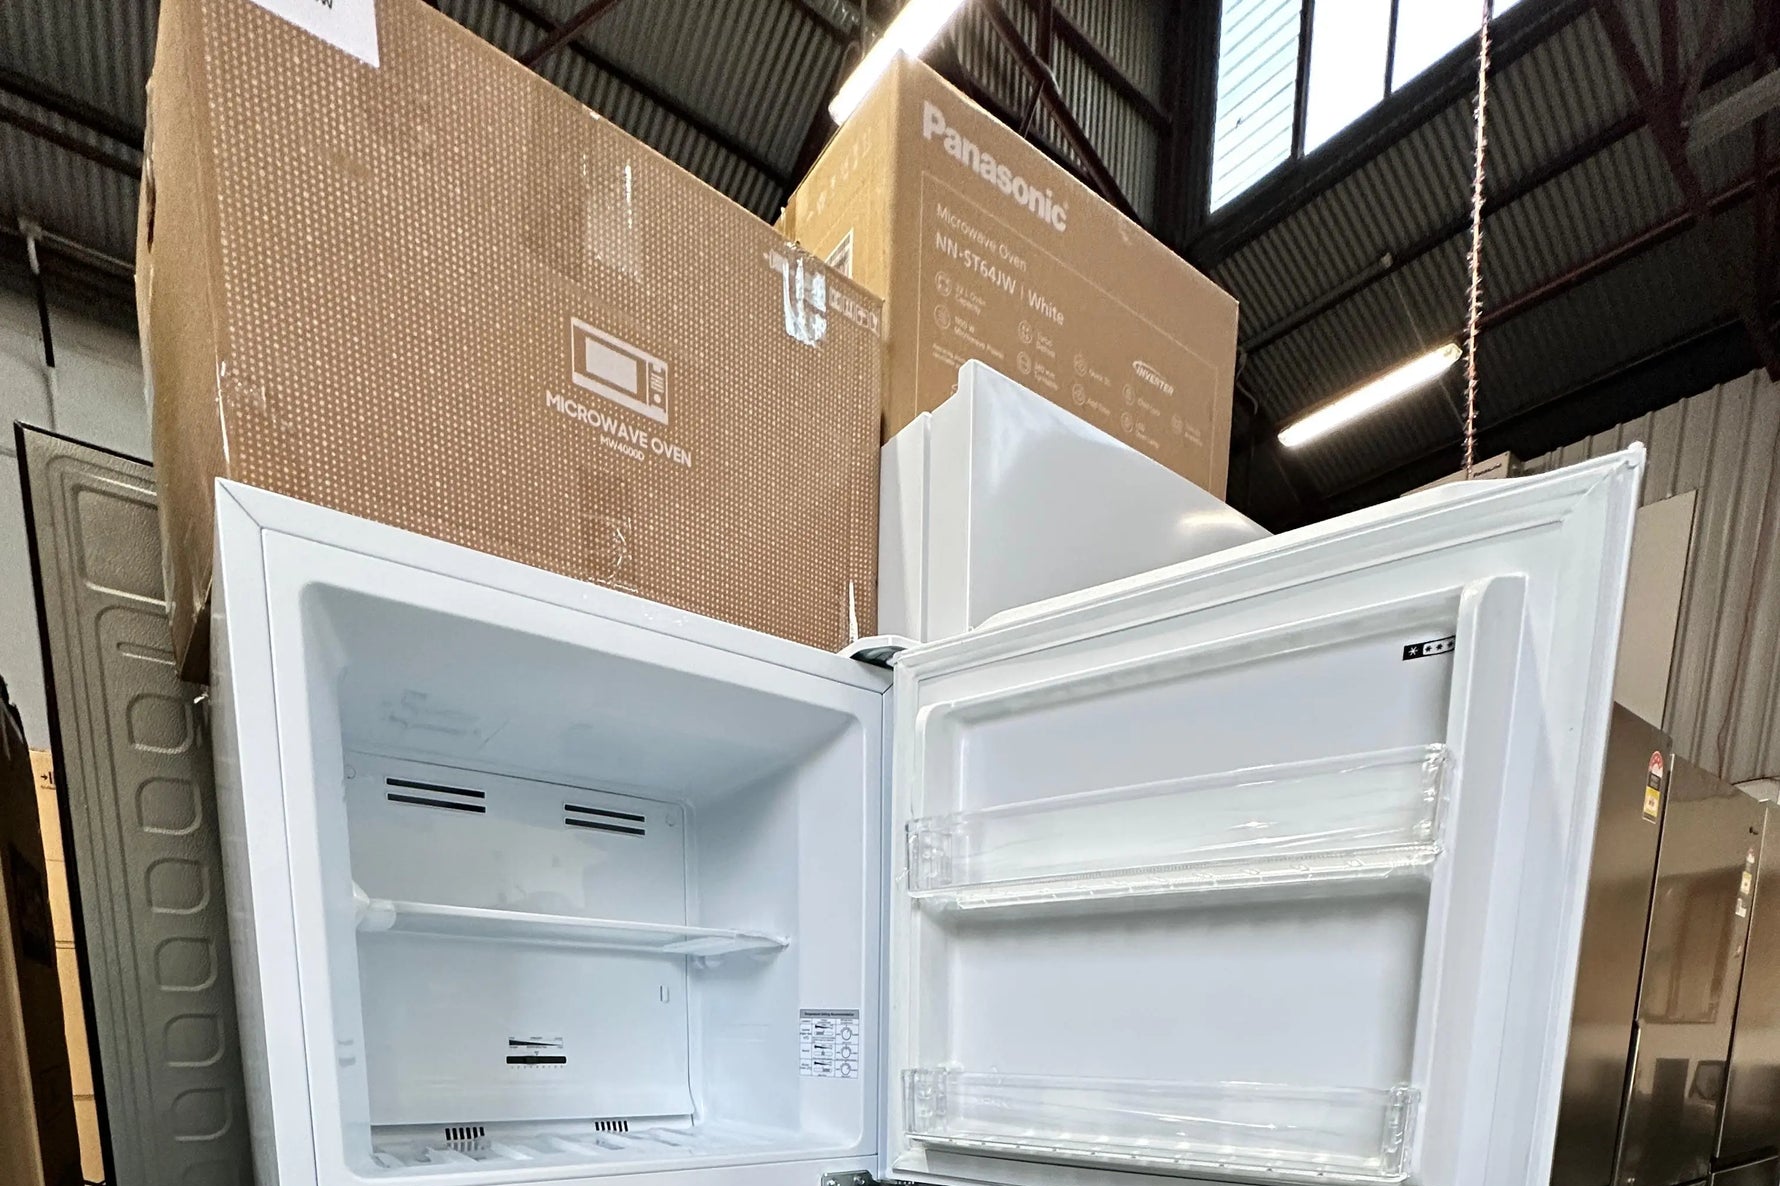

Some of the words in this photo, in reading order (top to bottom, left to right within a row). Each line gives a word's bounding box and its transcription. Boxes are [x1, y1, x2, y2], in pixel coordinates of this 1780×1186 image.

[923, 100, 1066, 232] Panasonic
[937, 203, 997, 253] Microwave
[999, 244, 1026, 272] Oven
[936, 231, 1017, 294] NN-ST64JW
[1028, 289, 1064, 326] White
[1135, 365, 1175, 396] INVERTER
[545, 389, 649, 449] MICROWAVE
[651, 436, 692, 468] OVEN
